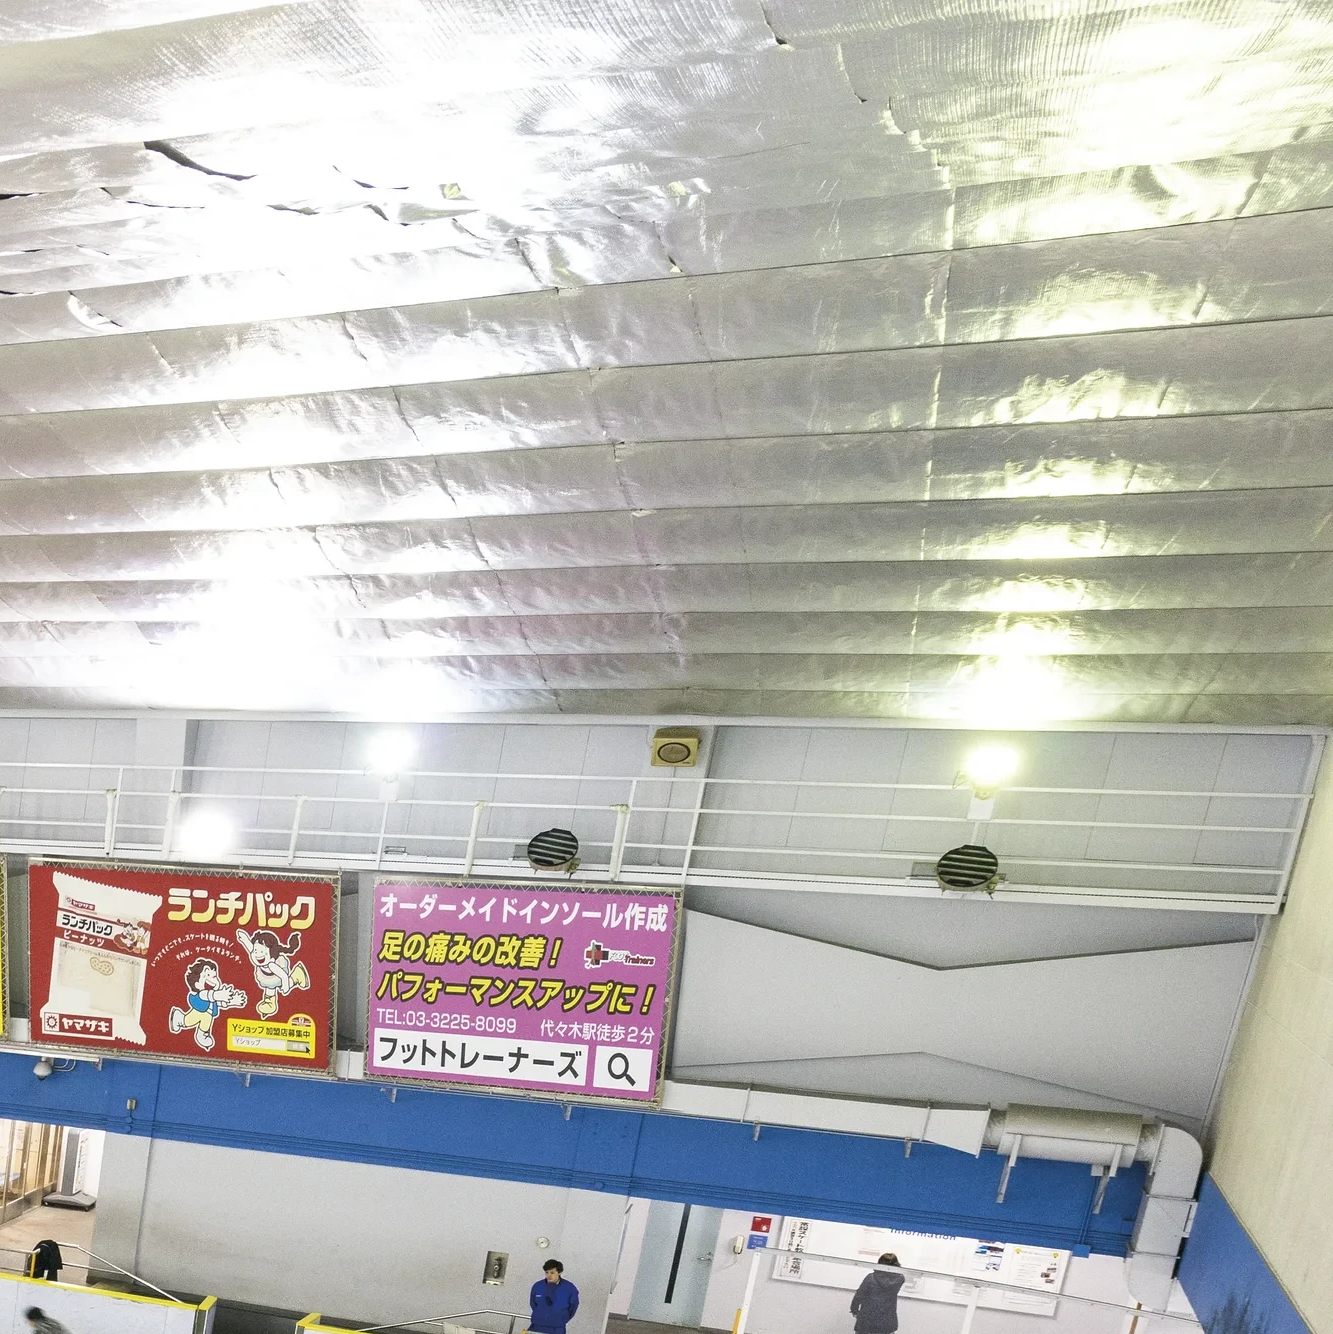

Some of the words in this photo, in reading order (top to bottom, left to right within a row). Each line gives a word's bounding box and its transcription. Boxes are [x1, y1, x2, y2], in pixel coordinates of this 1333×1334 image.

[73, 900, 95, 910] ヤマザキ
[167, 887, 316, 930] ランチパック
[380, 893, 669, 932] オーダーメイドインソール作成
[61, 913, 113, 936] ランチパック
[63, 930, 105, 947] ピーナッツ
[378, 931, 563, 969] 足の痛みの改善！
[376, 971, 655, 1015] パフォーマンスアップに！
[61, 1017, 110, 1033] ヤマザキ
[376, 1008, 516, 1033] TEL:03-3225-8099
[379, 1036, 582, 1080] フットトレーナーズ
